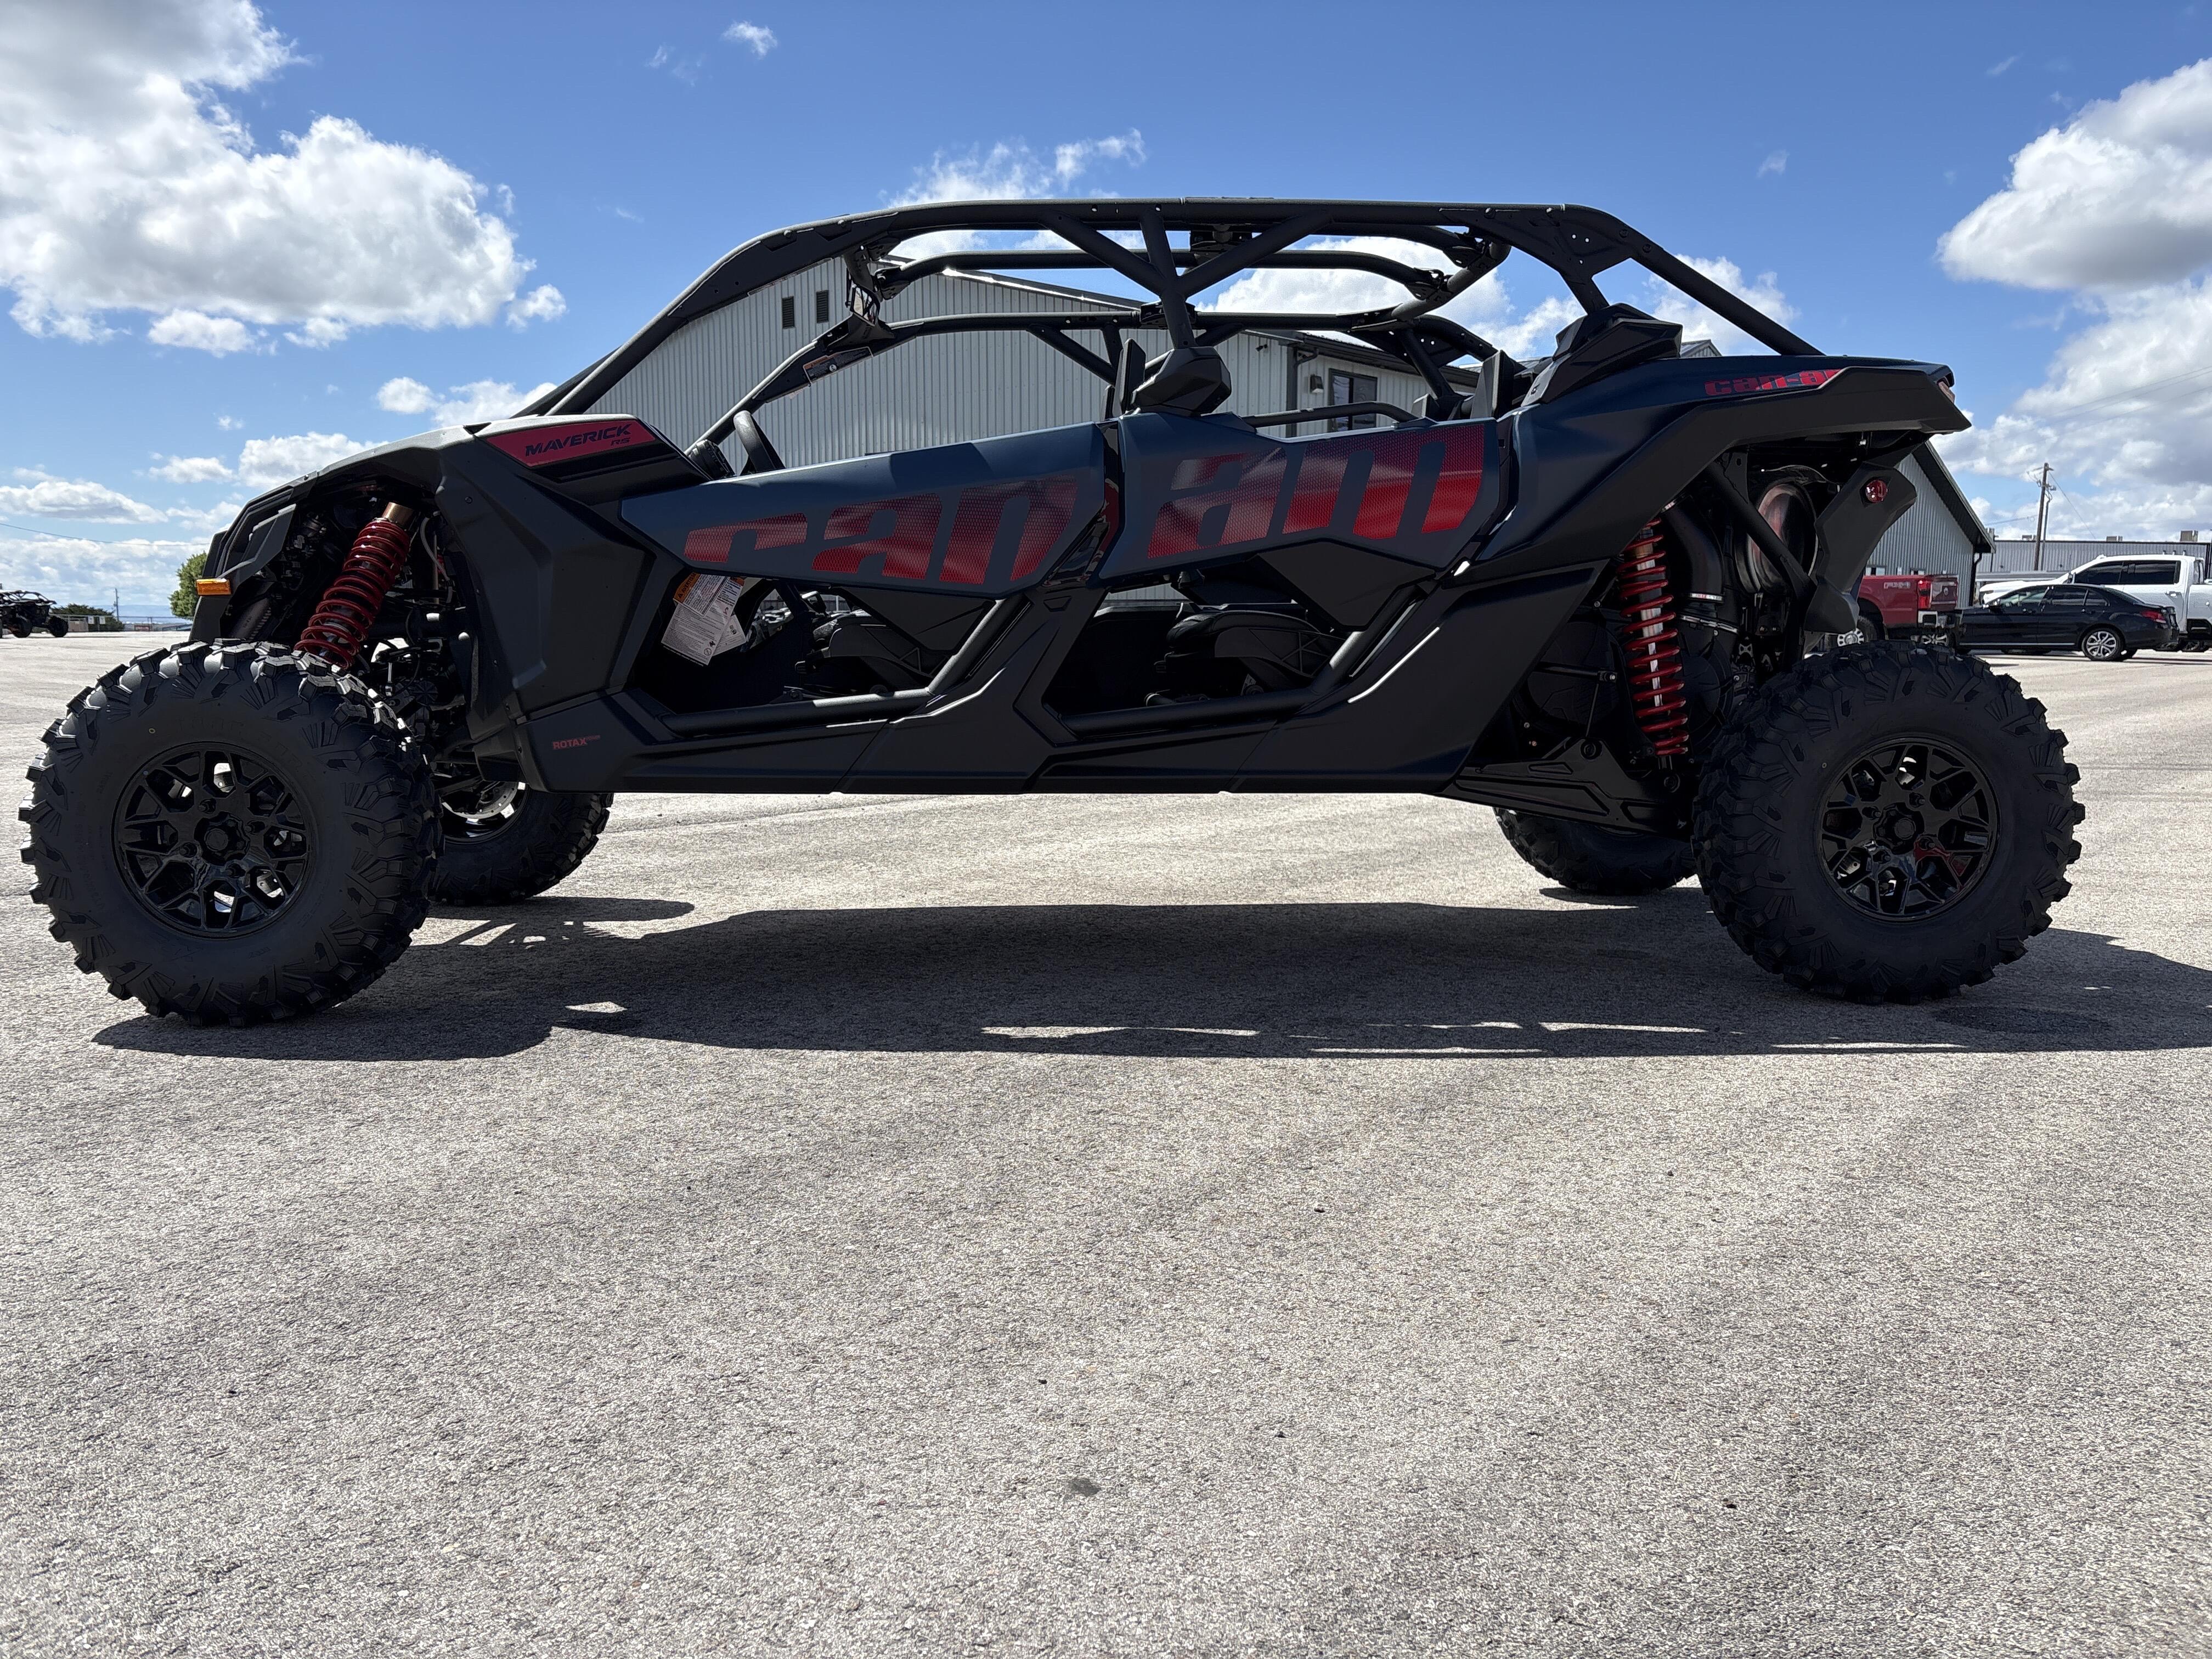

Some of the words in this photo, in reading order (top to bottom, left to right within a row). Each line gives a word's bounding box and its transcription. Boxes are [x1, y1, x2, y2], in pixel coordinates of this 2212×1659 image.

[525, 424, 631, 456] MAVERICK
[610, 437, 631, 446] RS
[552, 737, 587, 750] ROTAX
